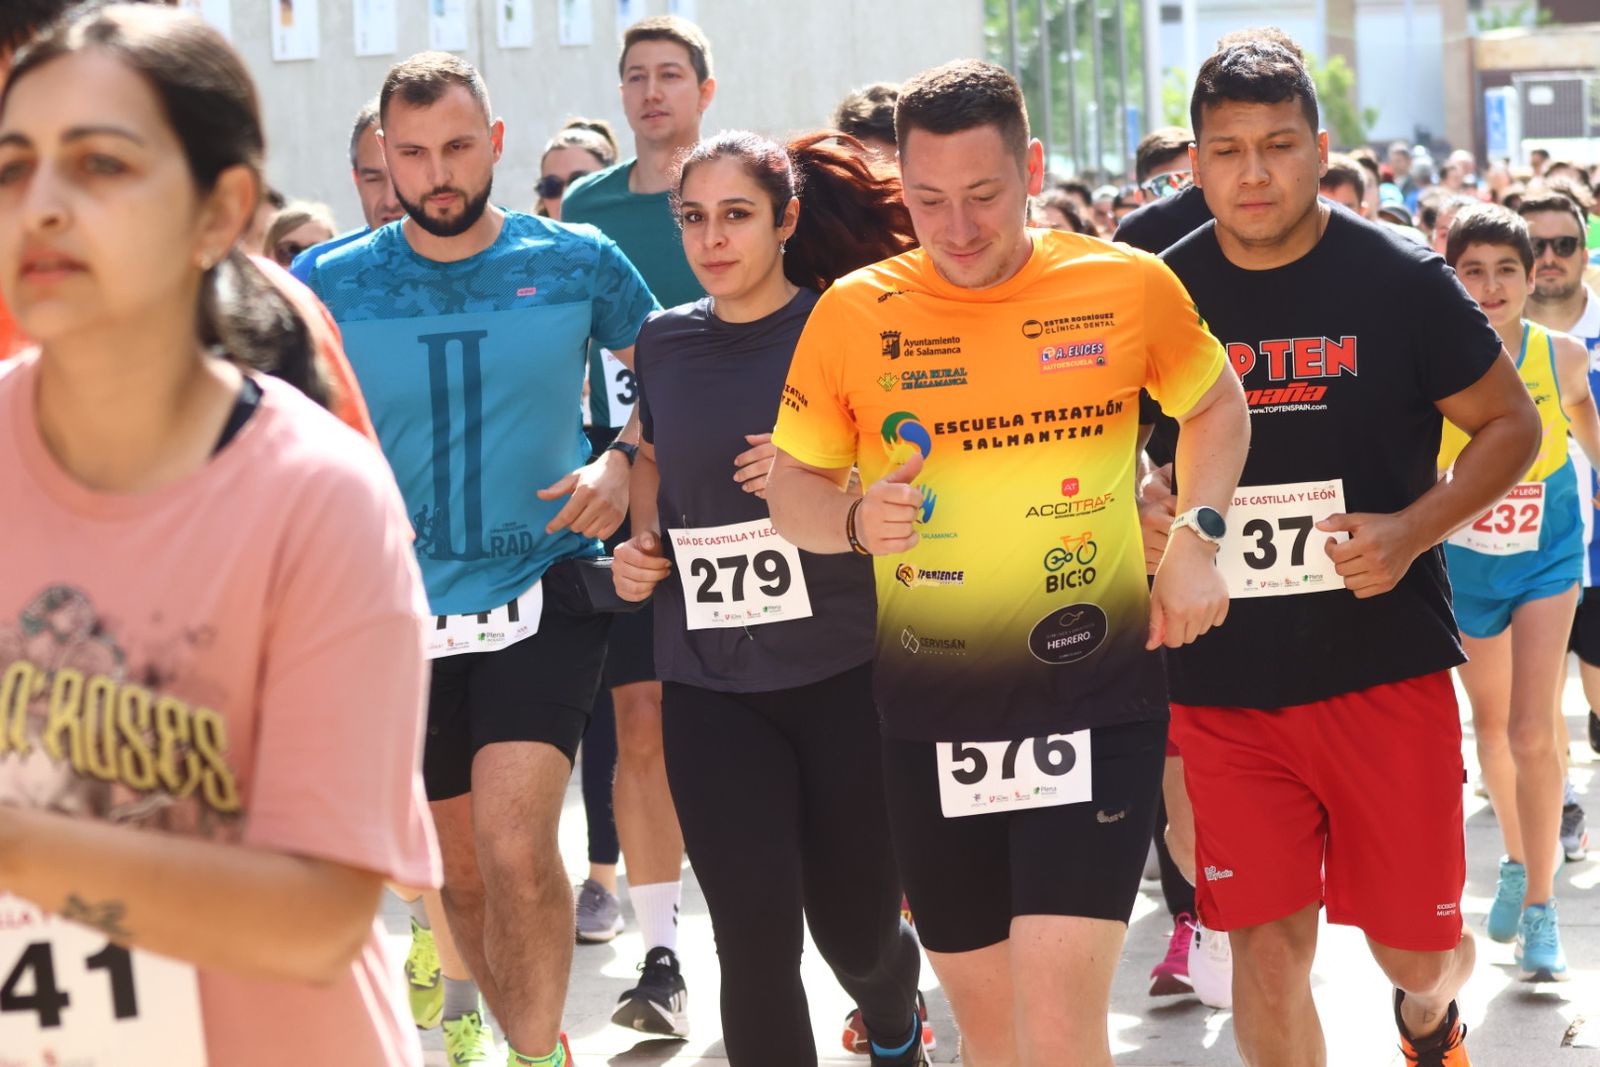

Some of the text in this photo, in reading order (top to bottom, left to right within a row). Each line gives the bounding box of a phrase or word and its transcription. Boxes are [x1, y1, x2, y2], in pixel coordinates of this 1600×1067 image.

[1045, 320, 1115, 334] CLÍNICA DENTAL
[903, 336, 961, 348] Ayuntamiento
[1068, 343, 1104, 358] ELICES
[904, 346, 961, 357] de Salamanca
[1260, 335, 1358, 381] TEN
[901, 367, 968, 382] CAJA RURAL
[934, 400, 1123, 436] ESCUELA TRIATLÓN
[962, 424, 1104, 451] SALMANTINA
[1234, 489, 1336, 506] DE CASTILLA Y LEÓN
[1519, 486, 1540, 496] LEÓN
[1472, 504, 1540, 534] 232
[677, 536, 692, 546] DÍA
[693, 537, 703, 546] DE
[705, 533, 748, 546] CASTILLA
[749, 530, 756, 539] Y
[1242, 515, 1314, 570] 37
[690, 549, 792, 603] 279
[1047, 631, 1091, 650] HERRERO
[951, 736, 1077, 786] 576
